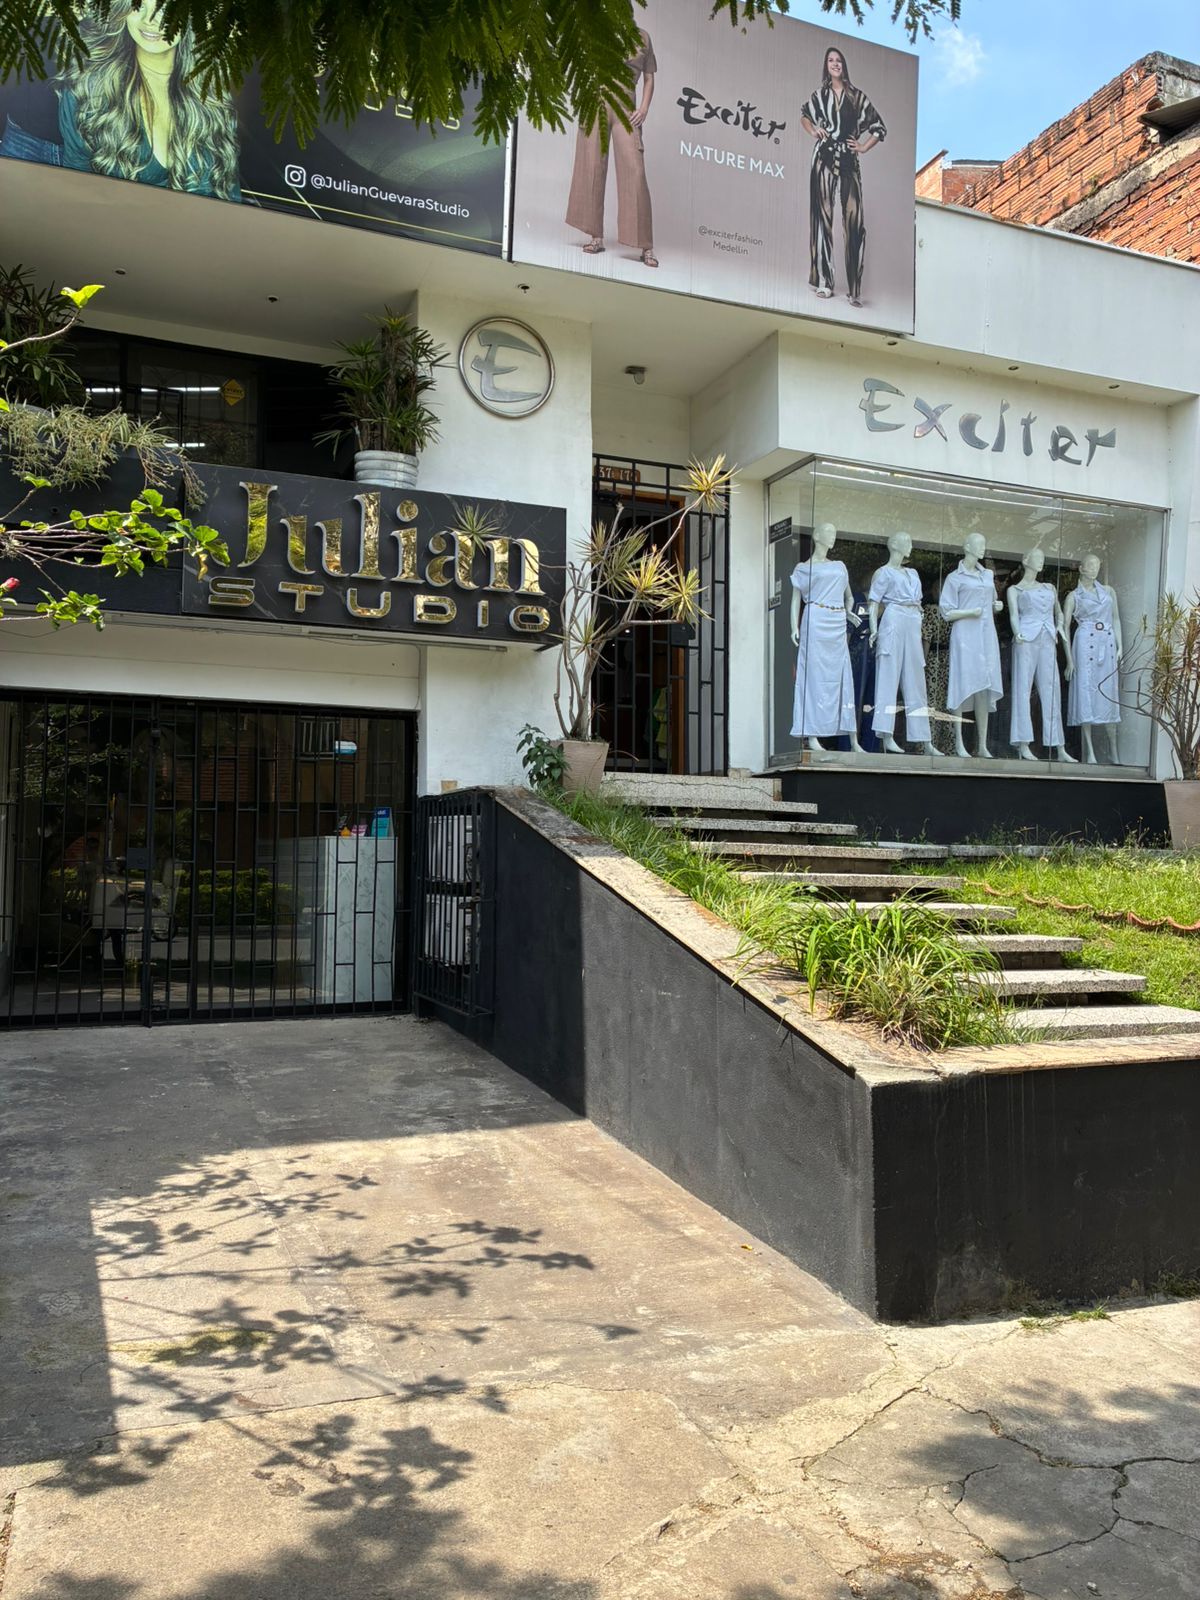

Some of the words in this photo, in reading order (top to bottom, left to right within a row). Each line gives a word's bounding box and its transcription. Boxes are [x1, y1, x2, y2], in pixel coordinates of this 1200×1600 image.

[677, 87, 786, 140] Exciter
[680, 140, 745, 170] NATURE
[750, 157, 785, 179] MAX
[311, 173, 470, 218] @JulianGuevaraStudio
[698, 225, 764, 246] @exciterfashion
[859, 378, 1116, 467] Exciter
[209, 482, 546, 595] Julian
[208, 576, 551, 632] STUDIO
